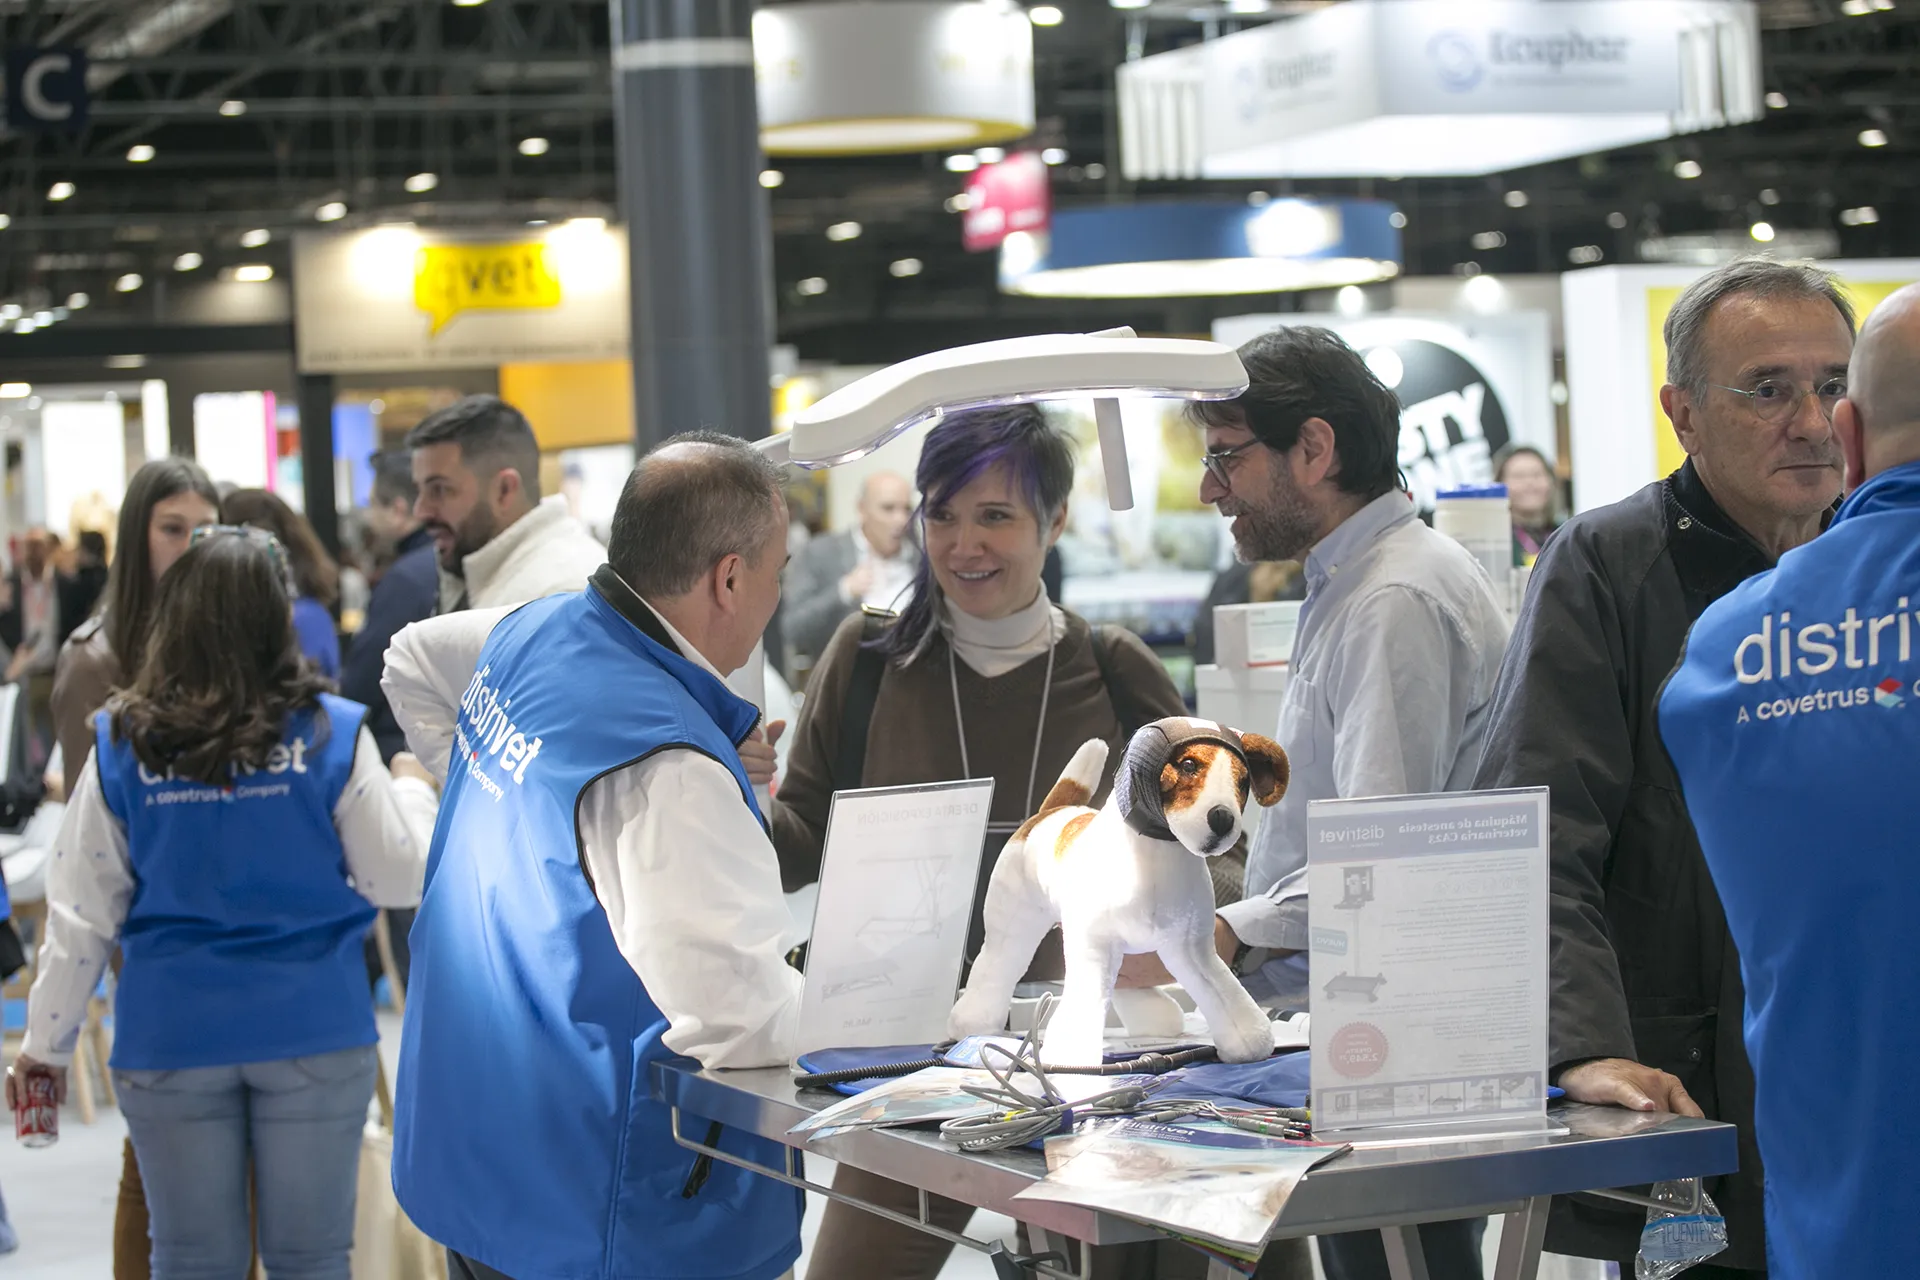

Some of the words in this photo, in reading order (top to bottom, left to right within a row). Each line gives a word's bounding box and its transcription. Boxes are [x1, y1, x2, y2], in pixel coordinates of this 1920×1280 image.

[20, 53, 73, 121] C
[1734, 596, 1920, 685] distri
[460, 664, 543, 785] distrivet
[1737, 705, 1750, 723] A
[1756, 687, 1869, 720] covetrus
[236, 783, 291, 800] Company
